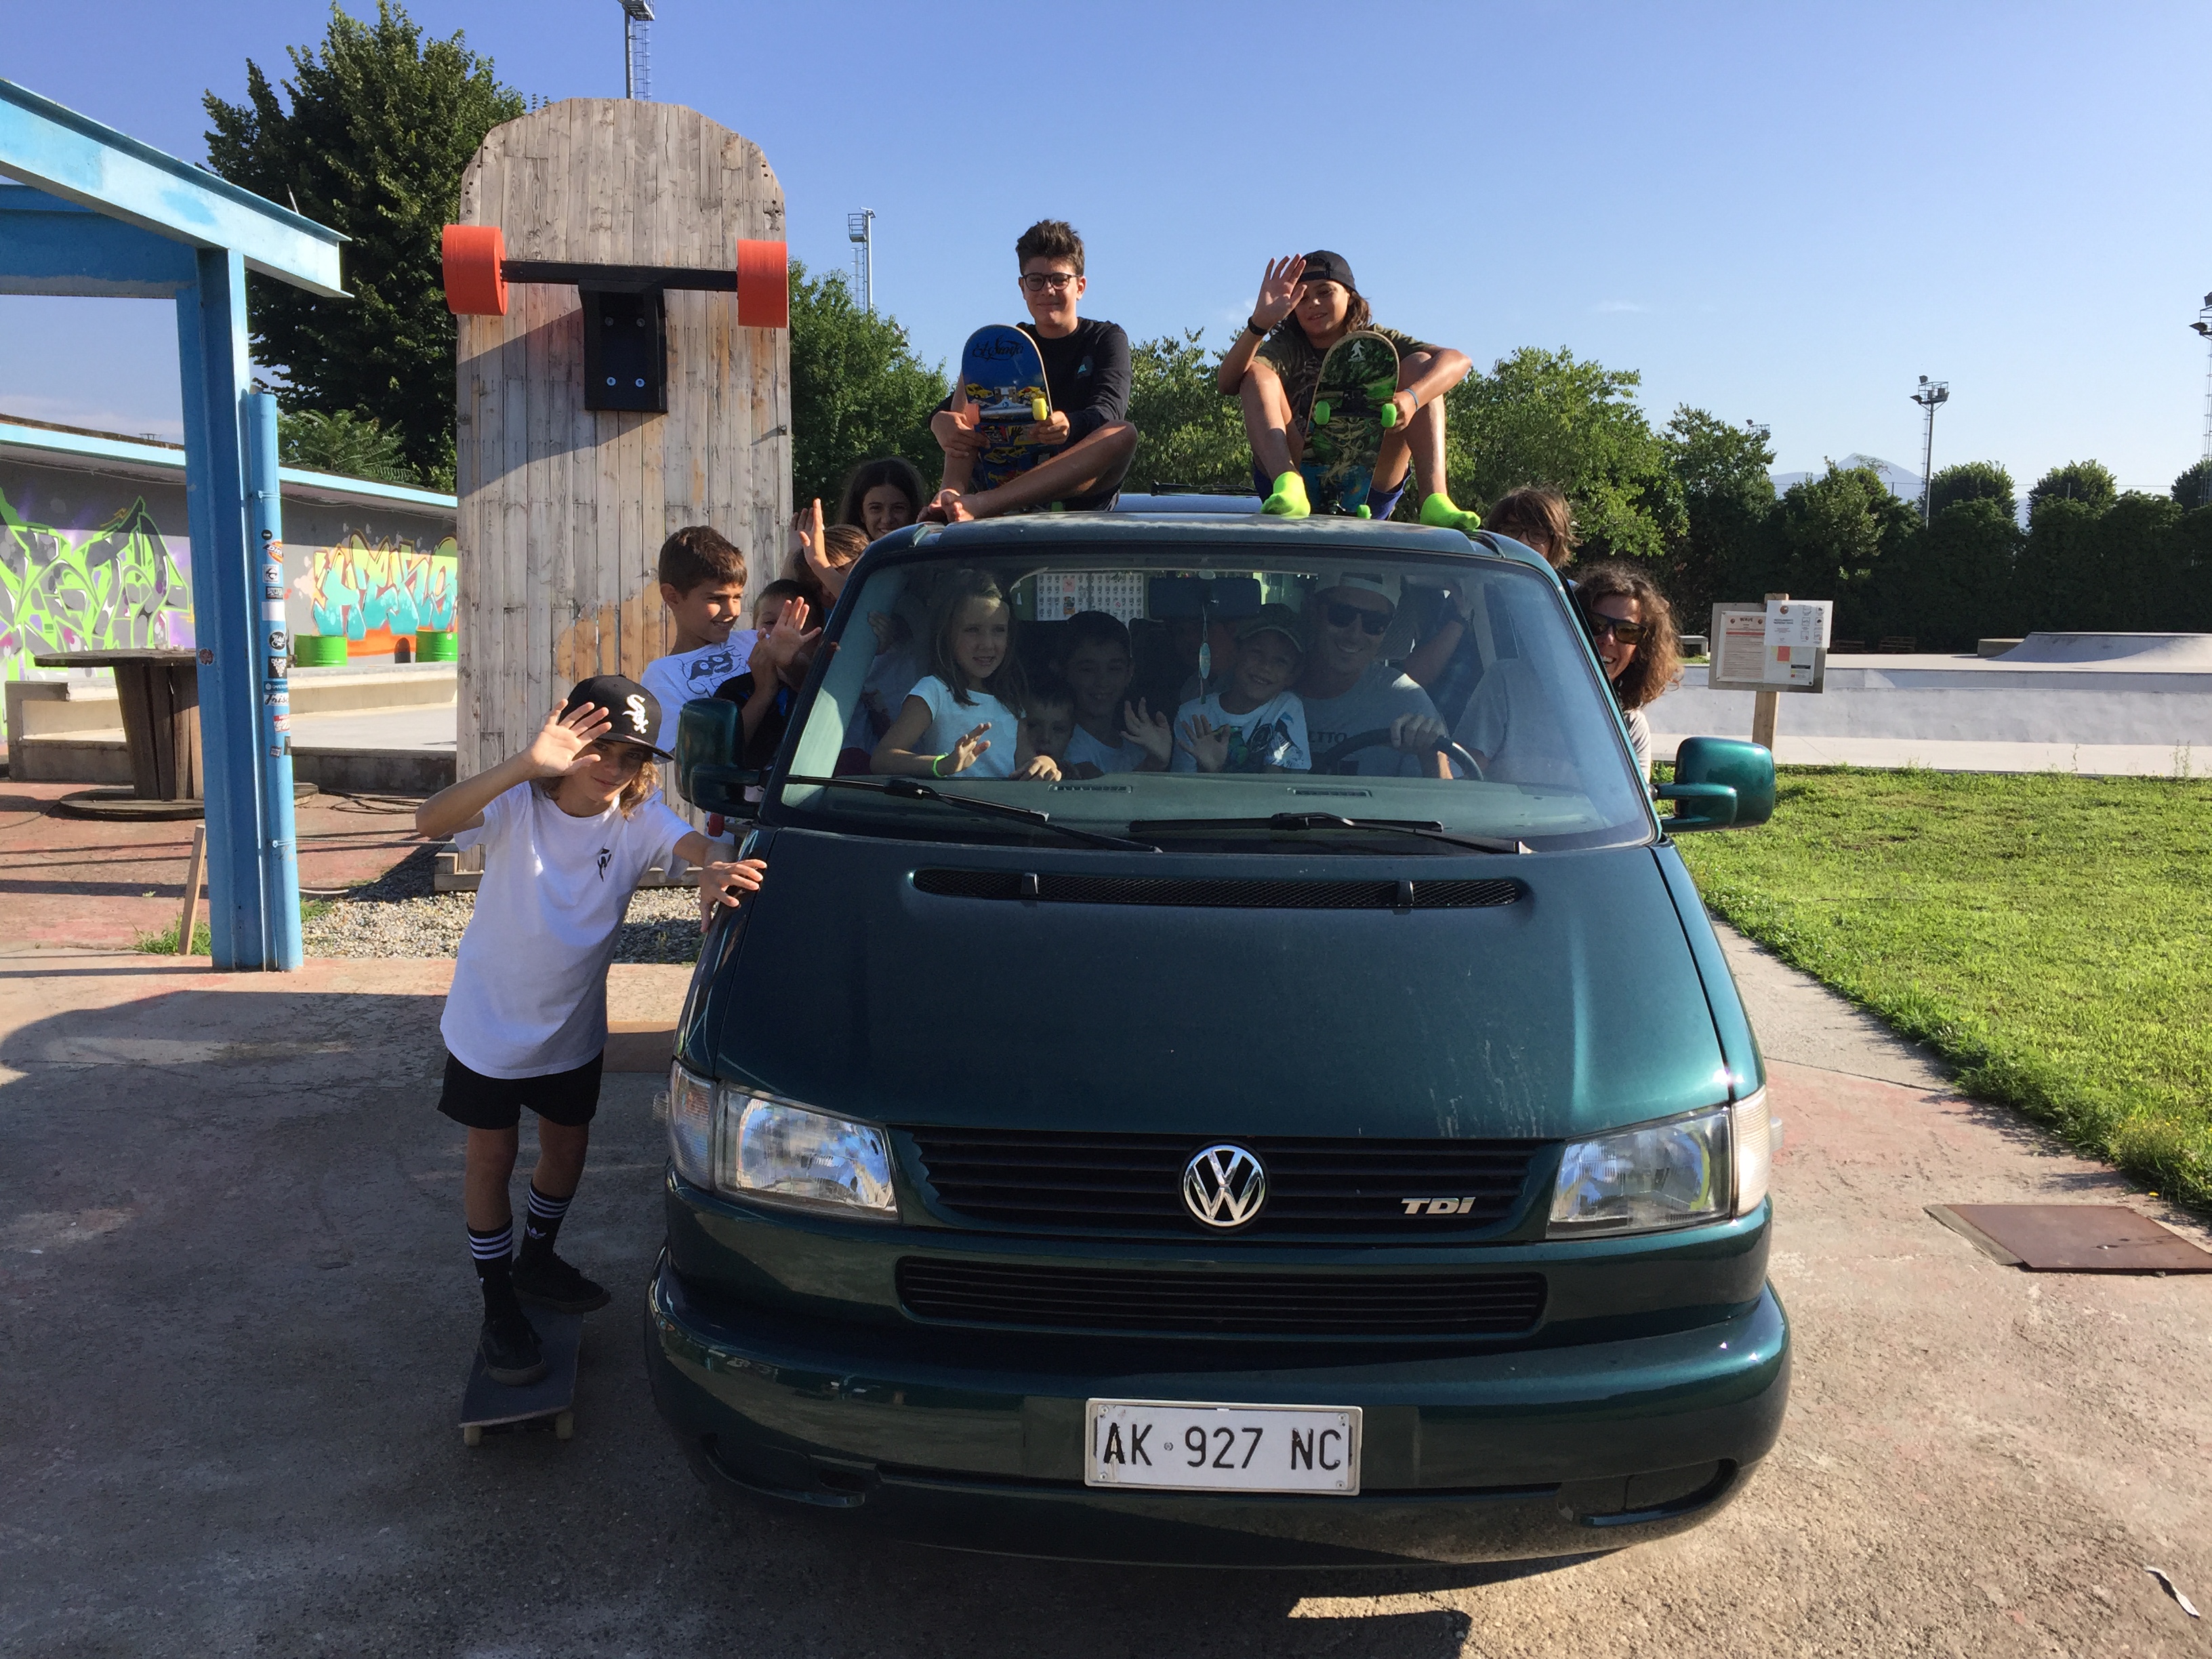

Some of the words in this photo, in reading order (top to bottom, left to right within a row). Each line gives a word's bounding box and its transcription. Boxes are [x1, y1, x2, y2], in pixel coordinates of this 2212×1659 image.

[1401, 1197, 1476, 1215] TDI
[1103, 1422, 1153, 1466] AK
[1184, 1426, 1264, 1469] 927
[1290, 1427, 1342, 1471] NC
